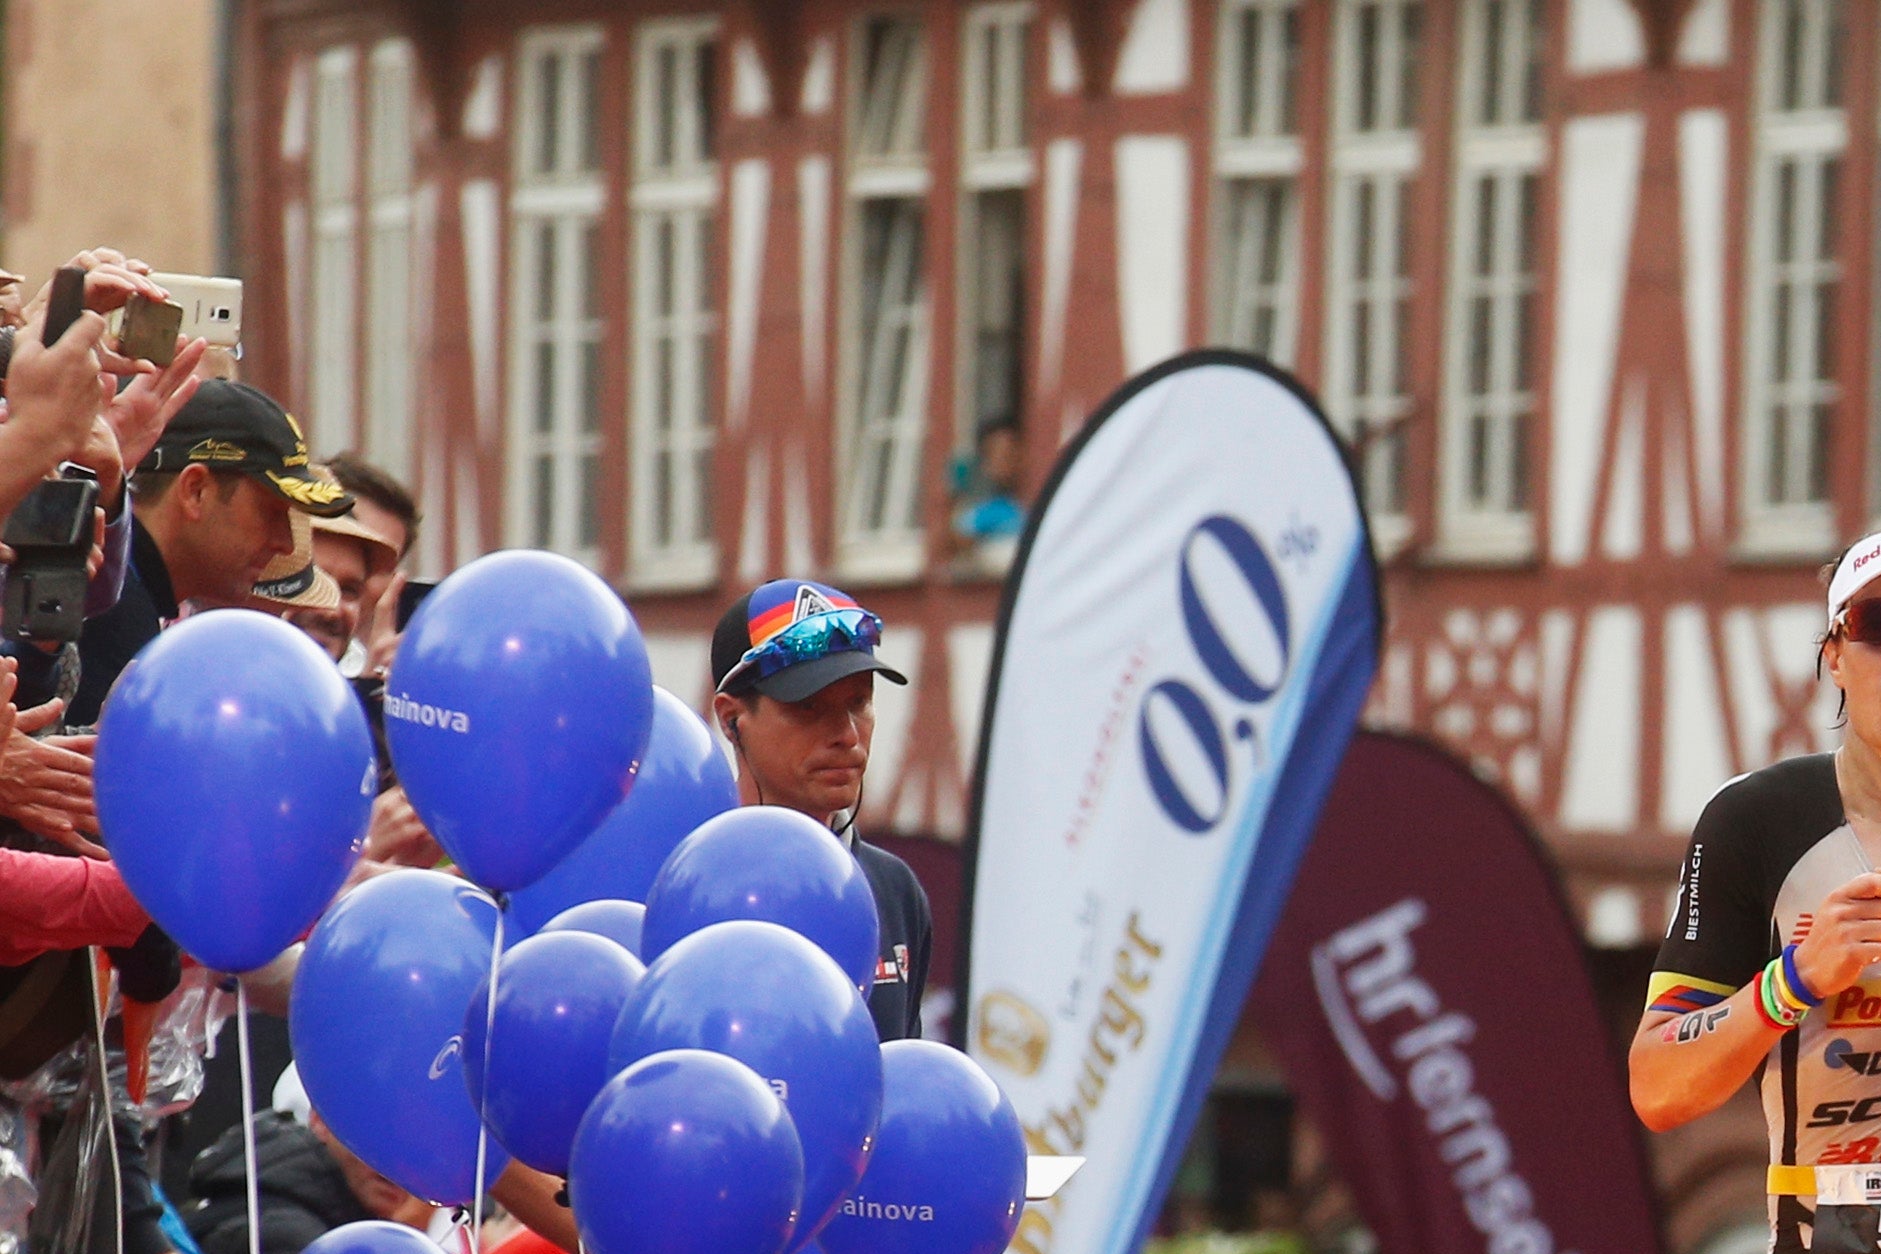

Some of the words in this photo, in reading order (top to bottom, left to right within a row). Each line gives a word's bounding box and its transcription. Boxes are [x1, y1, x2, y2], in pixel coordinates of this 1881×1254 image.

[1852, 545, 1880, 572] Red
[1684, 843, 1703, 941] BIESTMILCH
[1326, 898, 1440, 1024] hr
[838, 1195, 934, 1222] ainova
